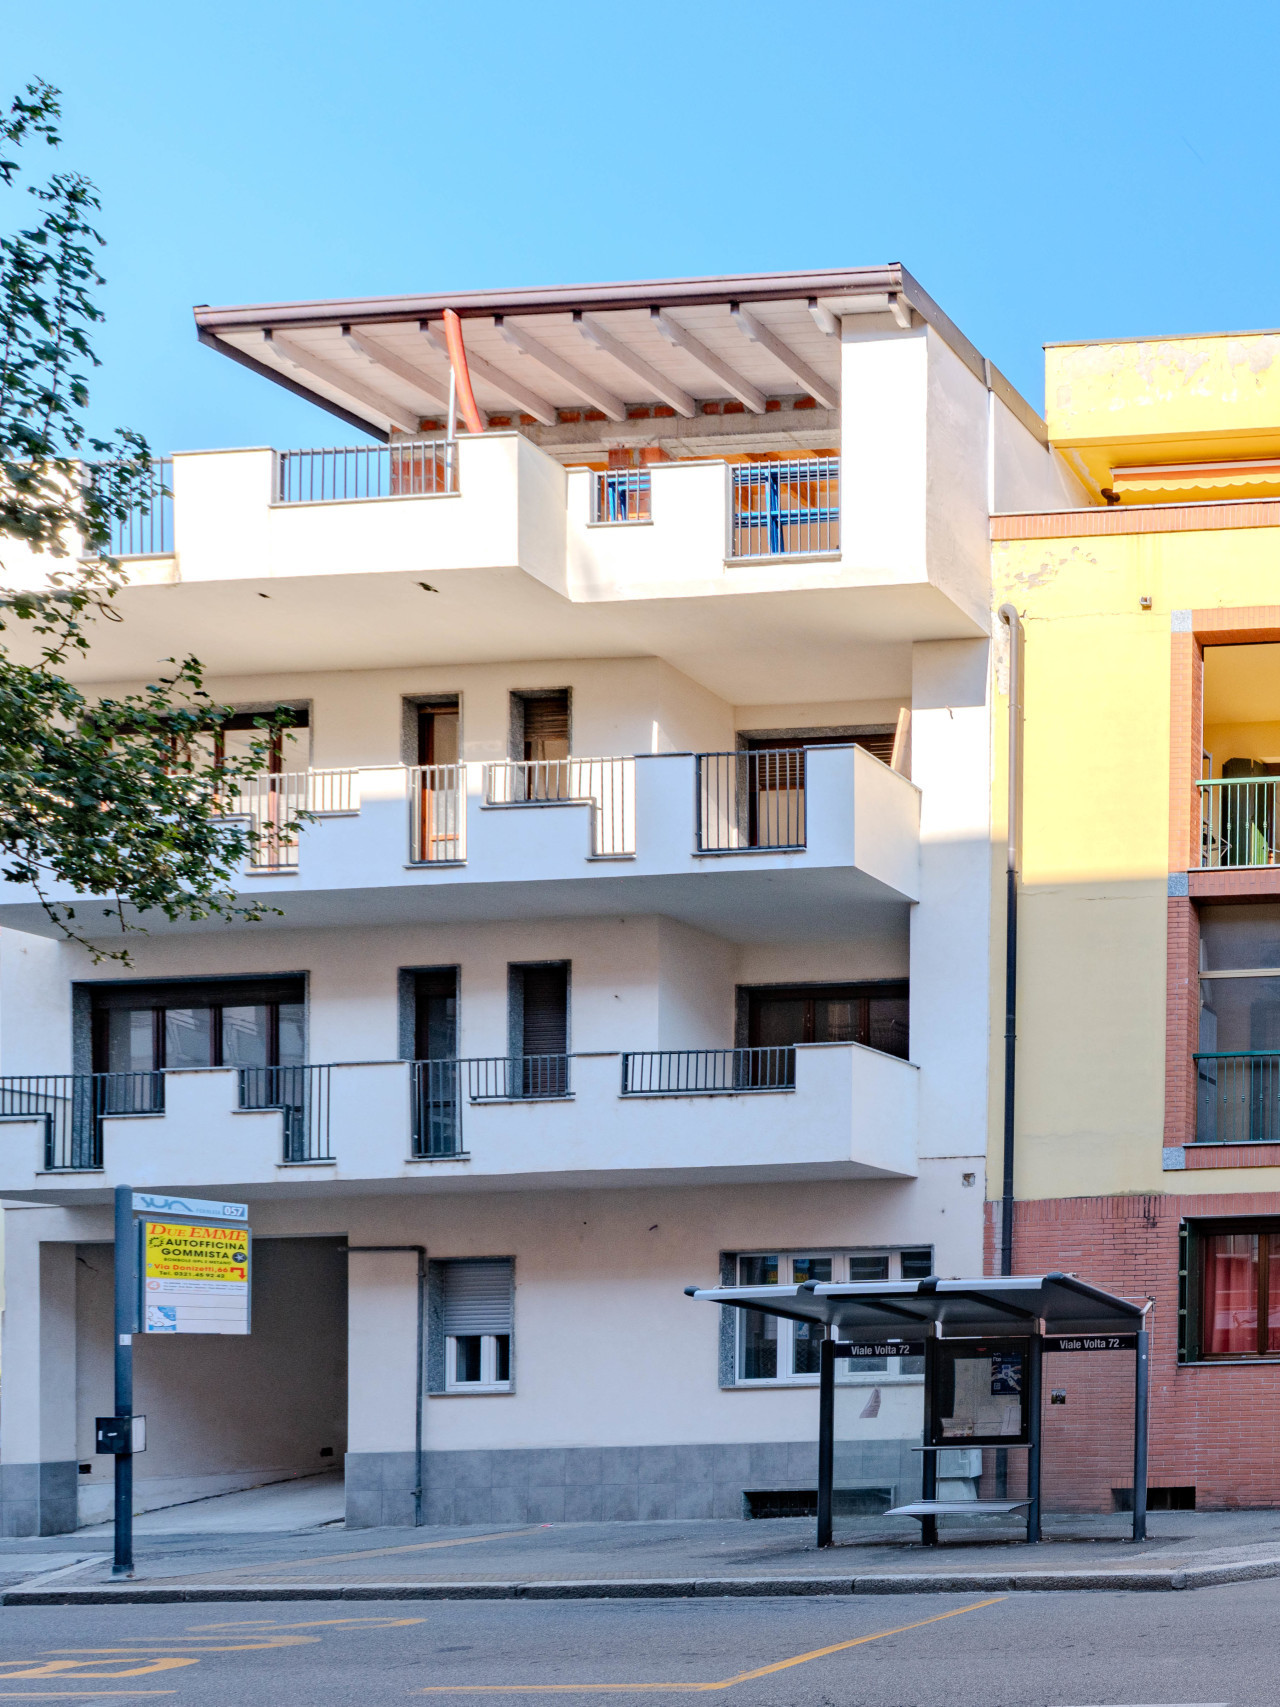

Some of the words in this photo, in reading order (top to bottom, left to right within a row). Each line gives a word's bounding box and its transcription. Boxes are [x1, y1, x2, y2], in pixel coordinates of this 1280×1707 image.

[224, 1206, 243, 1216] 057
[189, 1227, 248, 1242] EMME
[165, 1238, 246, 1251] AUTOFFICINA
[161, 1247, 230, 1259] GOMMISTA
[1060, 1339, 1082, 1349] Viale
[1083, 1338, 1106, 1349] Volta
[1108, 1338, 1120, 1348] 72
[851, 1345, 873, 1355] Viale
[874, 1345, 896, 1355] Volta
[899, 1344, 910, 1354] 72
